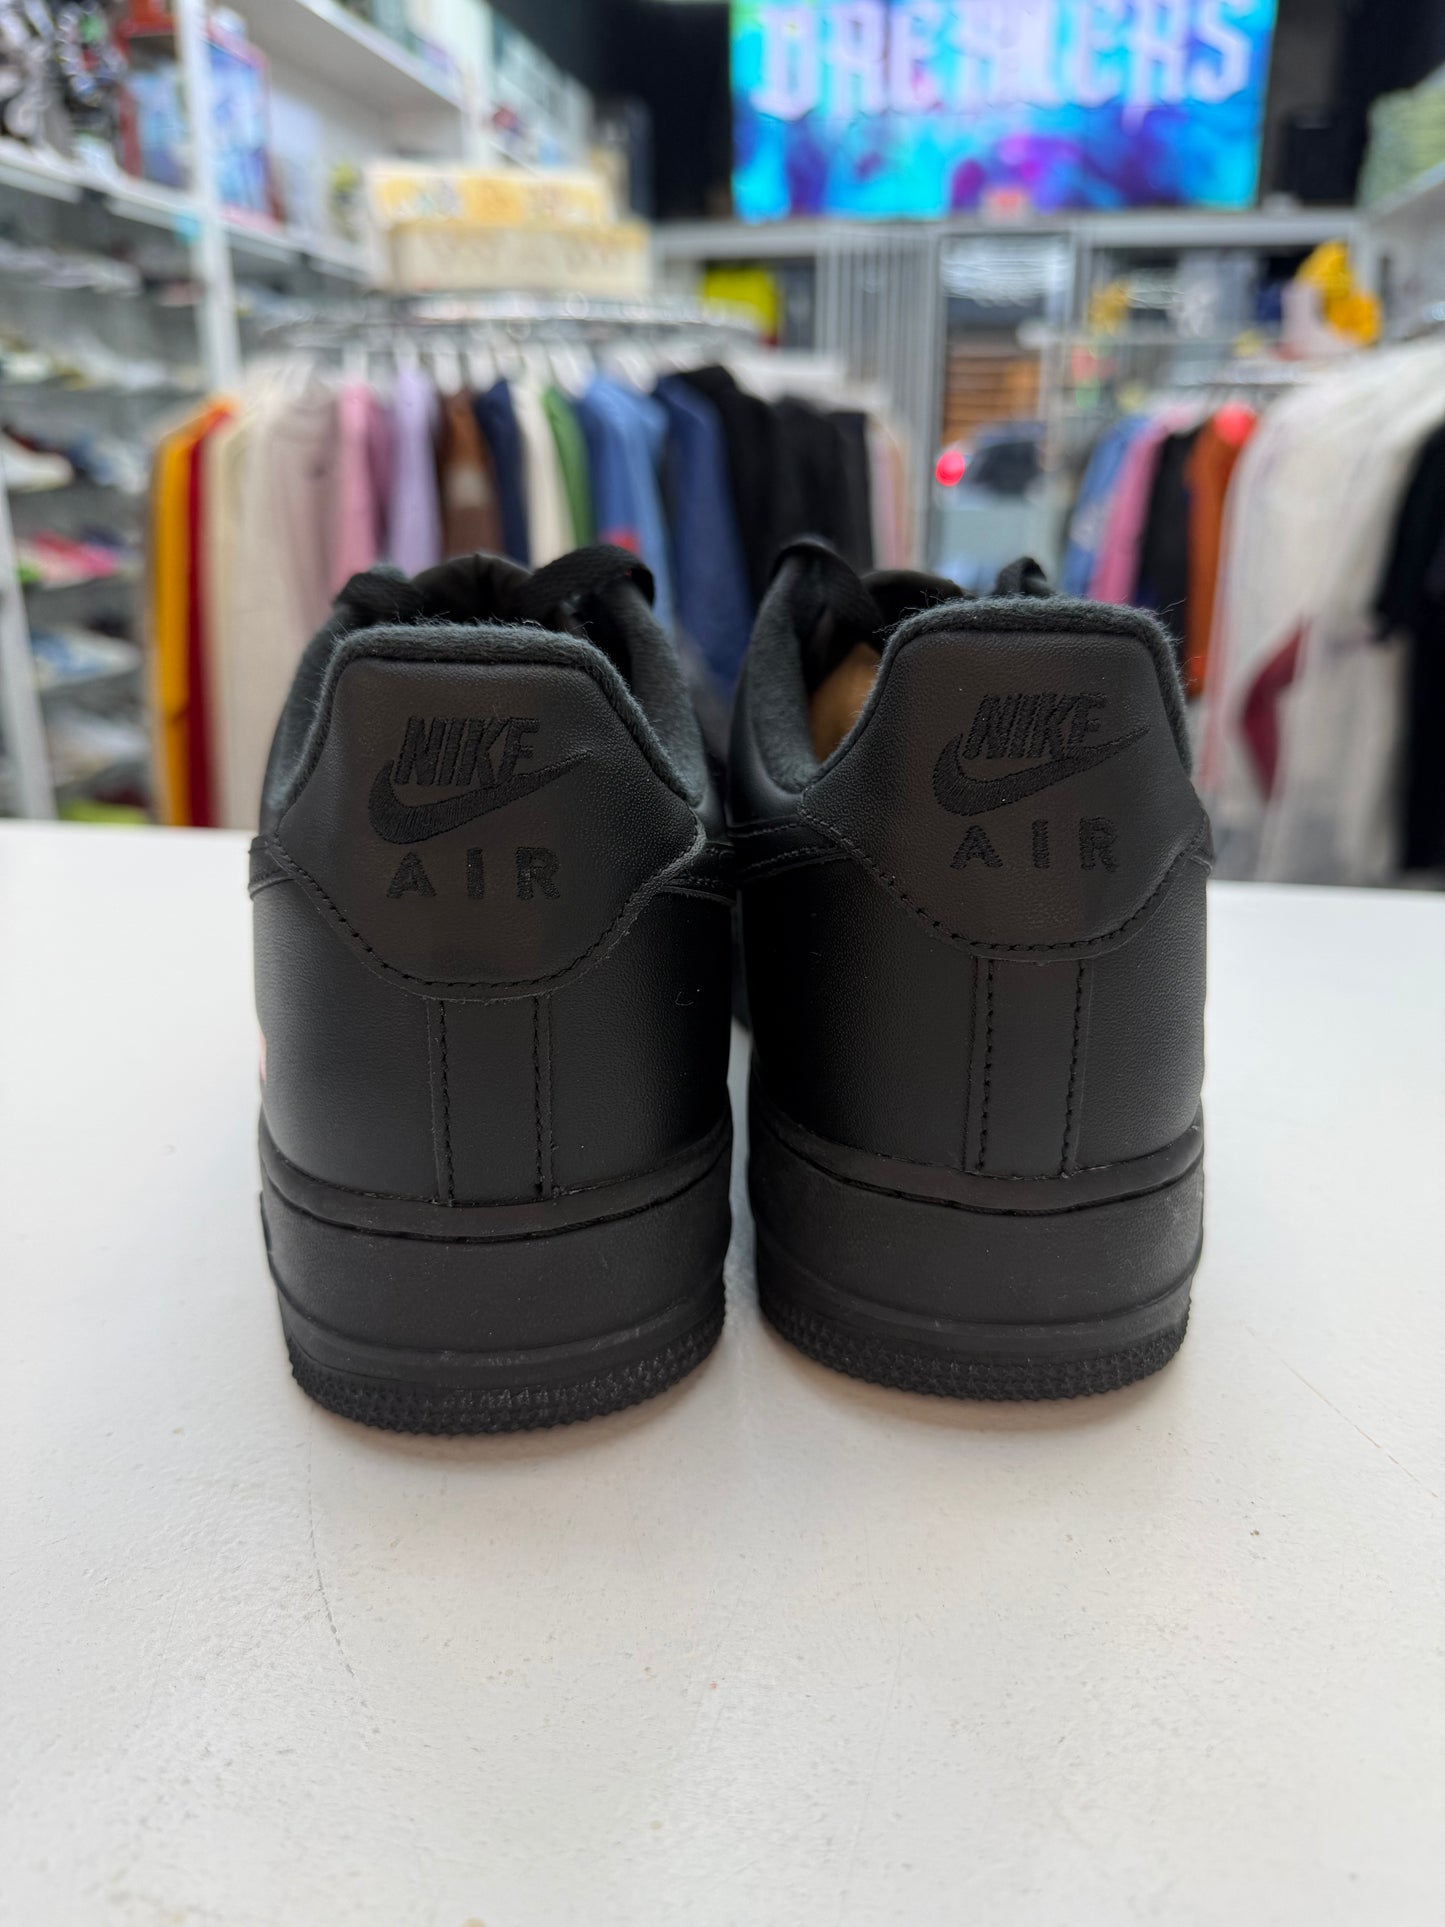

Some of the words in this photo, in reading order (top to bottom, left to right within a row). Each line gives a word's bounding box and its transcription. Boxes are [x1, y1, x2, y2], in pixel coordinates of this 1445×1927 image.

[394, 716, 540, 786] NIKE
[962, 693, 1105, 761] NIKE
[386, 846, 560, 899] AIR
[950, 817, 1119, 872] AIR
